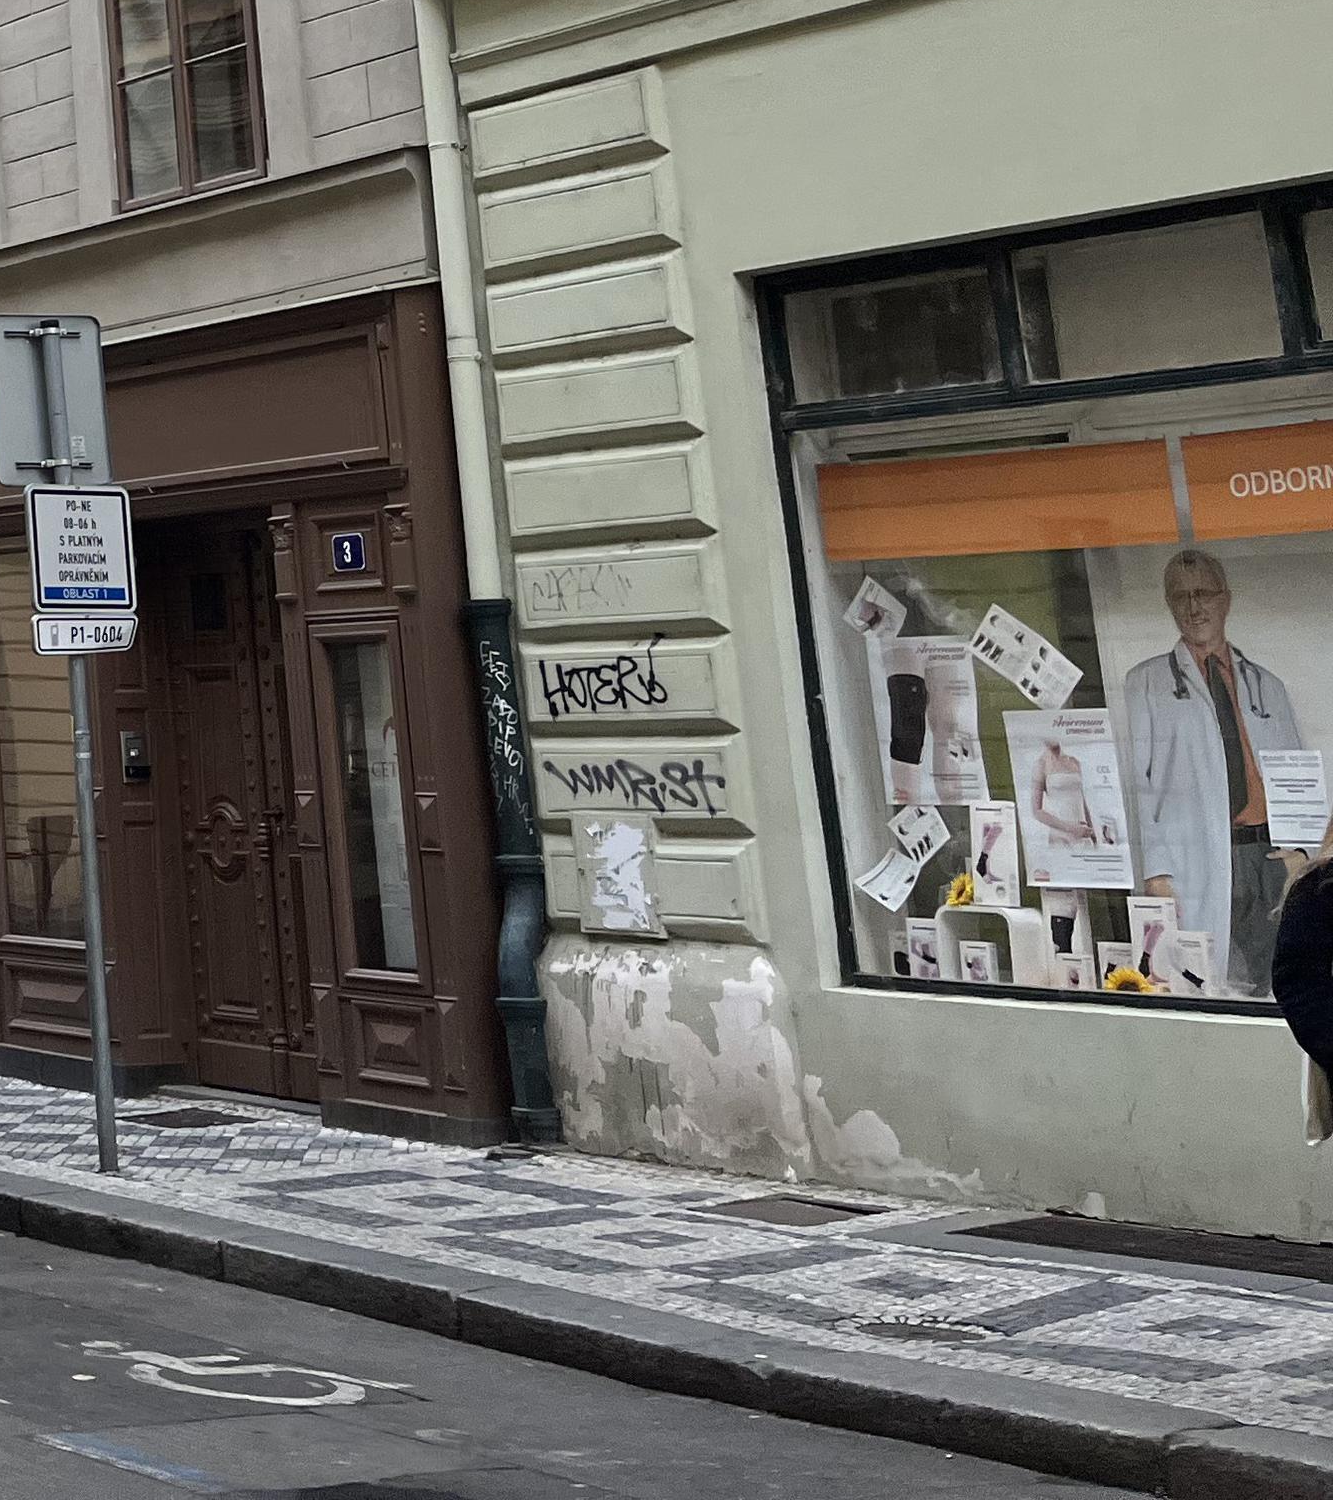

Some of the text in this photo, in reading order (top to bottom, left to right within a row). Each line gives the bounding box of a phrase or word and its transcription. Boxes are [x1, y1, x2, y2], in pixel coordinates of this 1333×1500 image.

[65, 500, 92, 512] PO-NE
[91, 518, 97, 530] h
[59, 533, 104, 547] S PLATNÝM
[58, 550, 107, 565] PARKOVACÍM
[343, 541, 352, 563] 3
[58, 568, 109, 583] OPRÁVNĚNÍM
[62, 588, 108, 599] OBLAST 1
[70, 626, 123, 644] P1-0604
